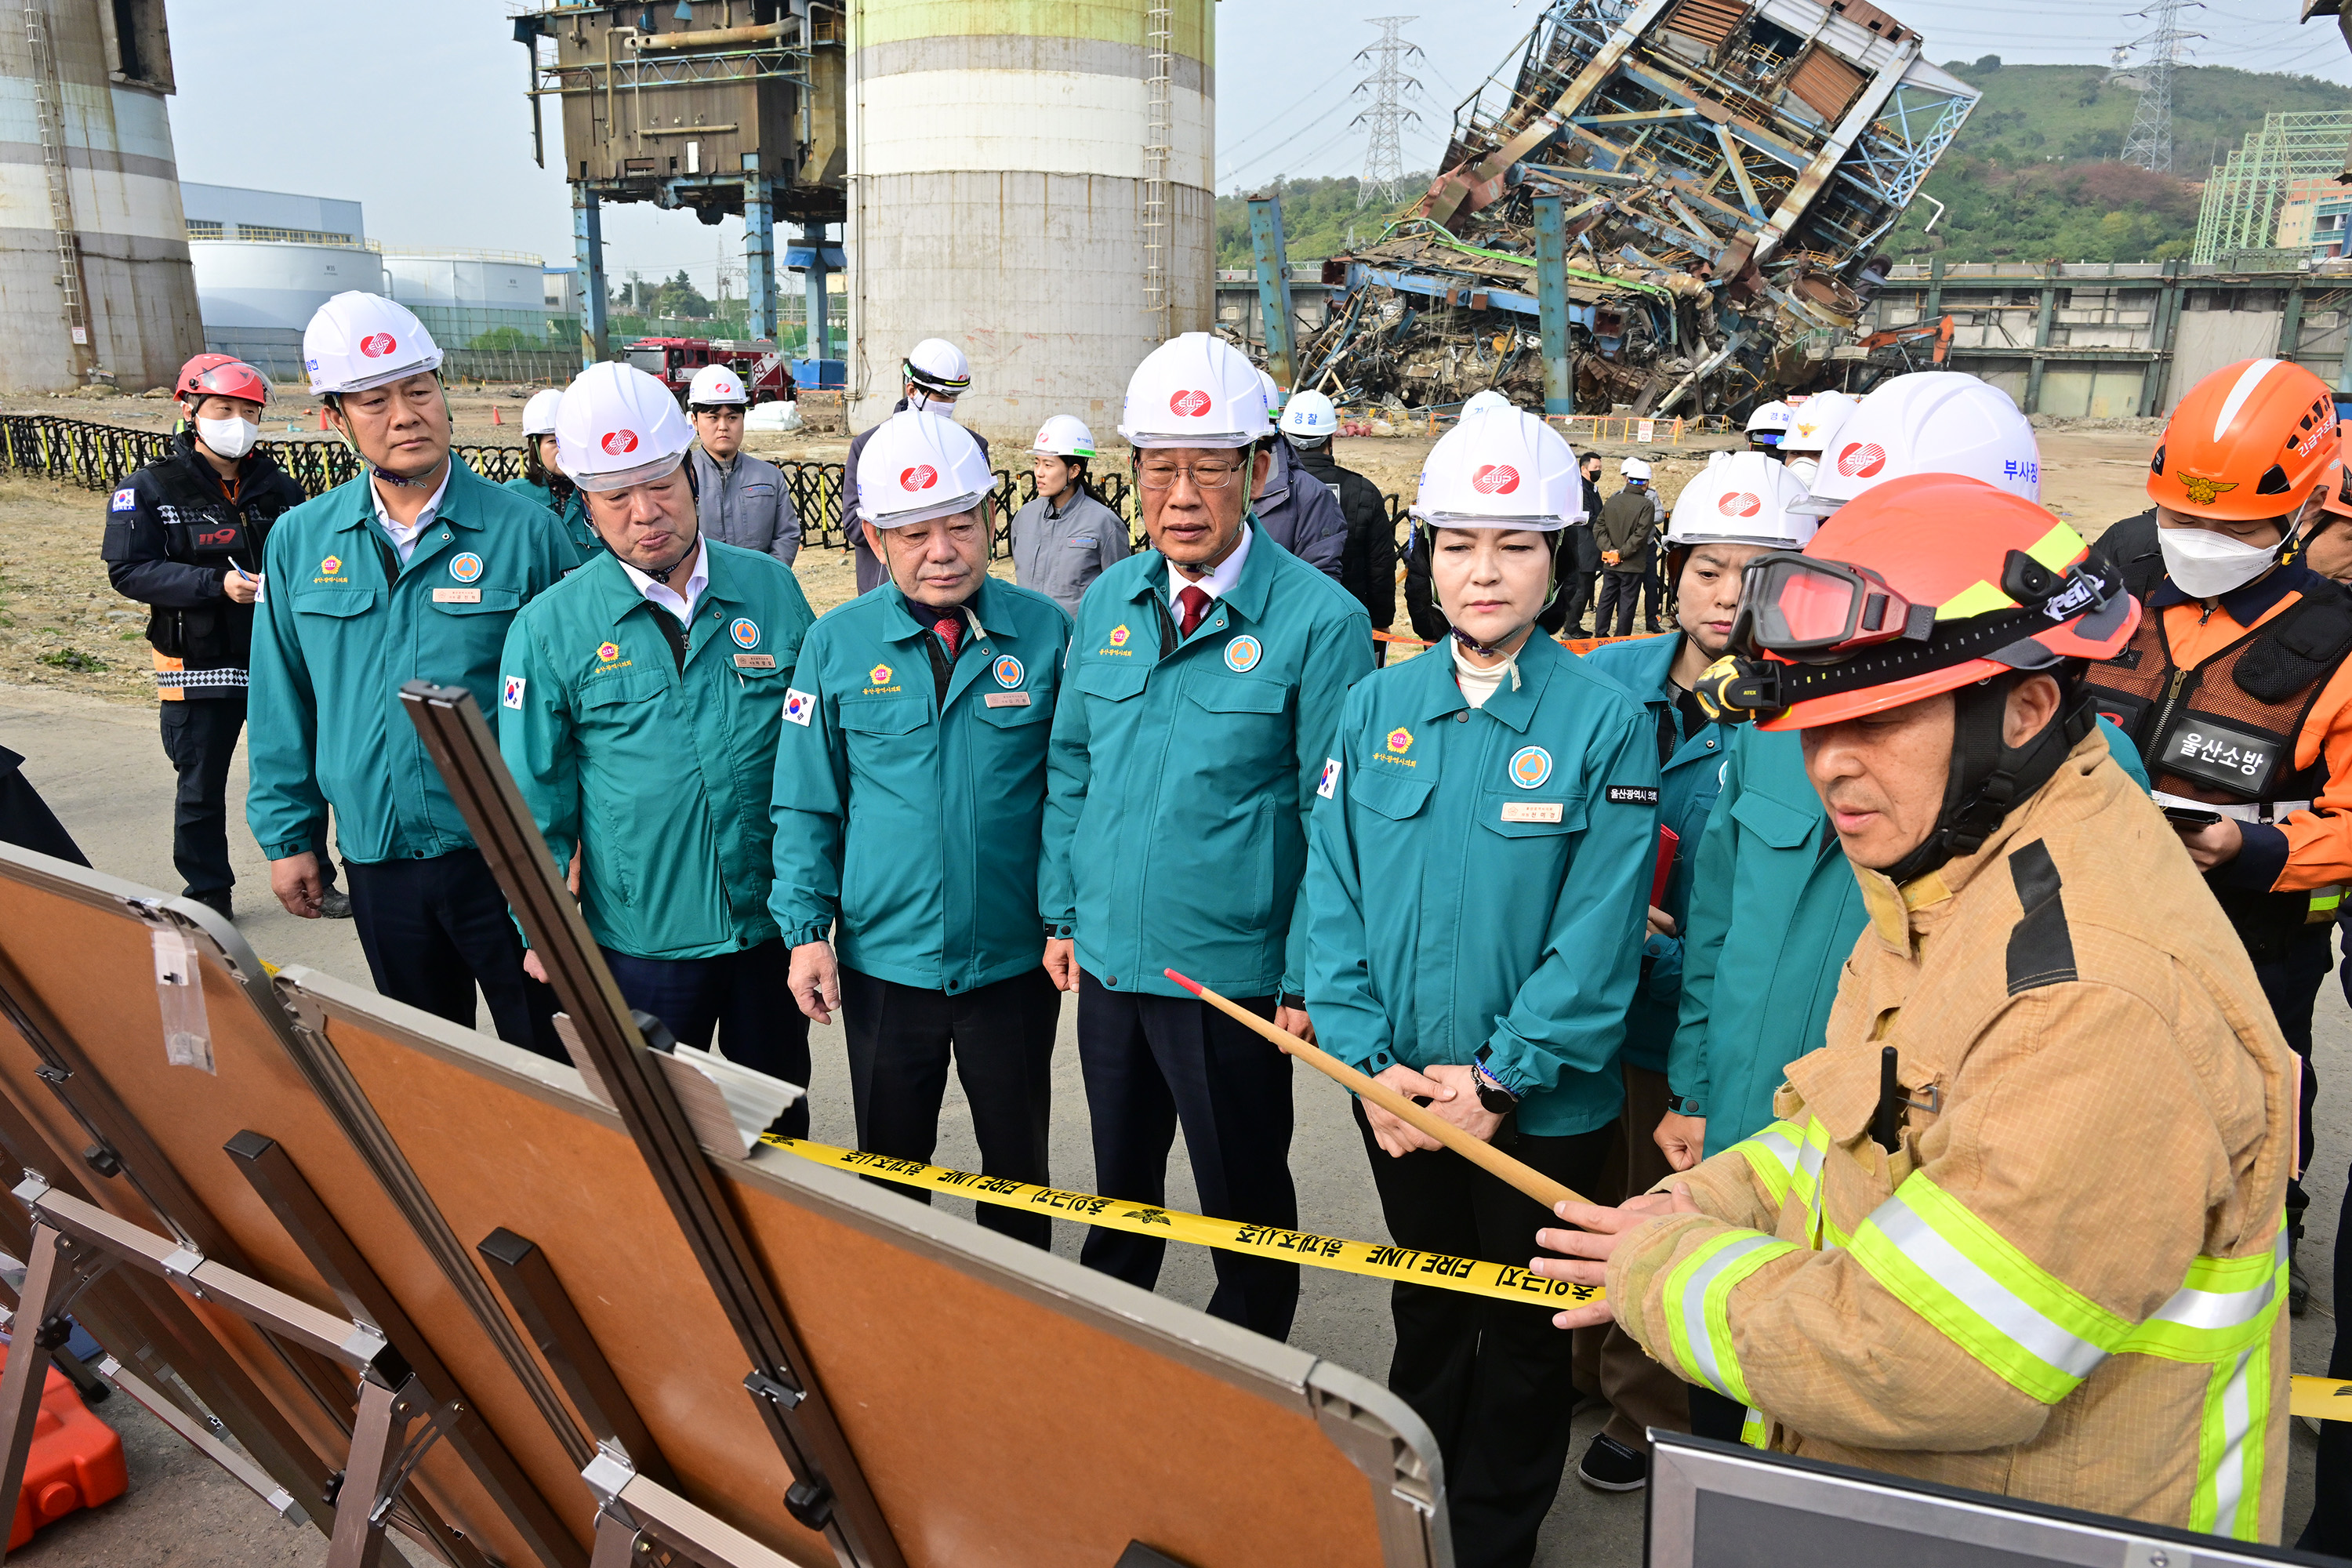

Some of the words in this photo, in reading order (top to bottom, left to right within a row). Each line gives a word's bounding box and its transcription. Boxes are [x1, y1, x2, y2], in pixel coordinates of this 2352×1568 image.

[1178, 398, 1205, 408] EWP
[1294, 412, 1318, 426] 경찰
[608, 436, 632, 448] EWP
[1845, 454, 1878, 466] EWP
[908, 471, 931, 484] EWP
[2003, 459, 2038, 484] 부사장
[1481, 474, 1512, 485] EWP
[1726, 499, 1755, 510] EWP
[199, 528, 237, 546] 119
[1392, 735, 1407, 745] 의회
[2180, 732, 2263, 776] 울산소방
[1610, 788, 1646, 801] 울산광역시
[1647, 790, 1657, 802] 의회
[937, 1169, 978, 1188] LINE
[977, 1175, 1025, 1196] FIRE
[1236, 1222, 1349, 1258] 화재조사중
[1367, 1244, 1422, 1269] LINE
[1420, 1254, 1477, 1279] FIRE
